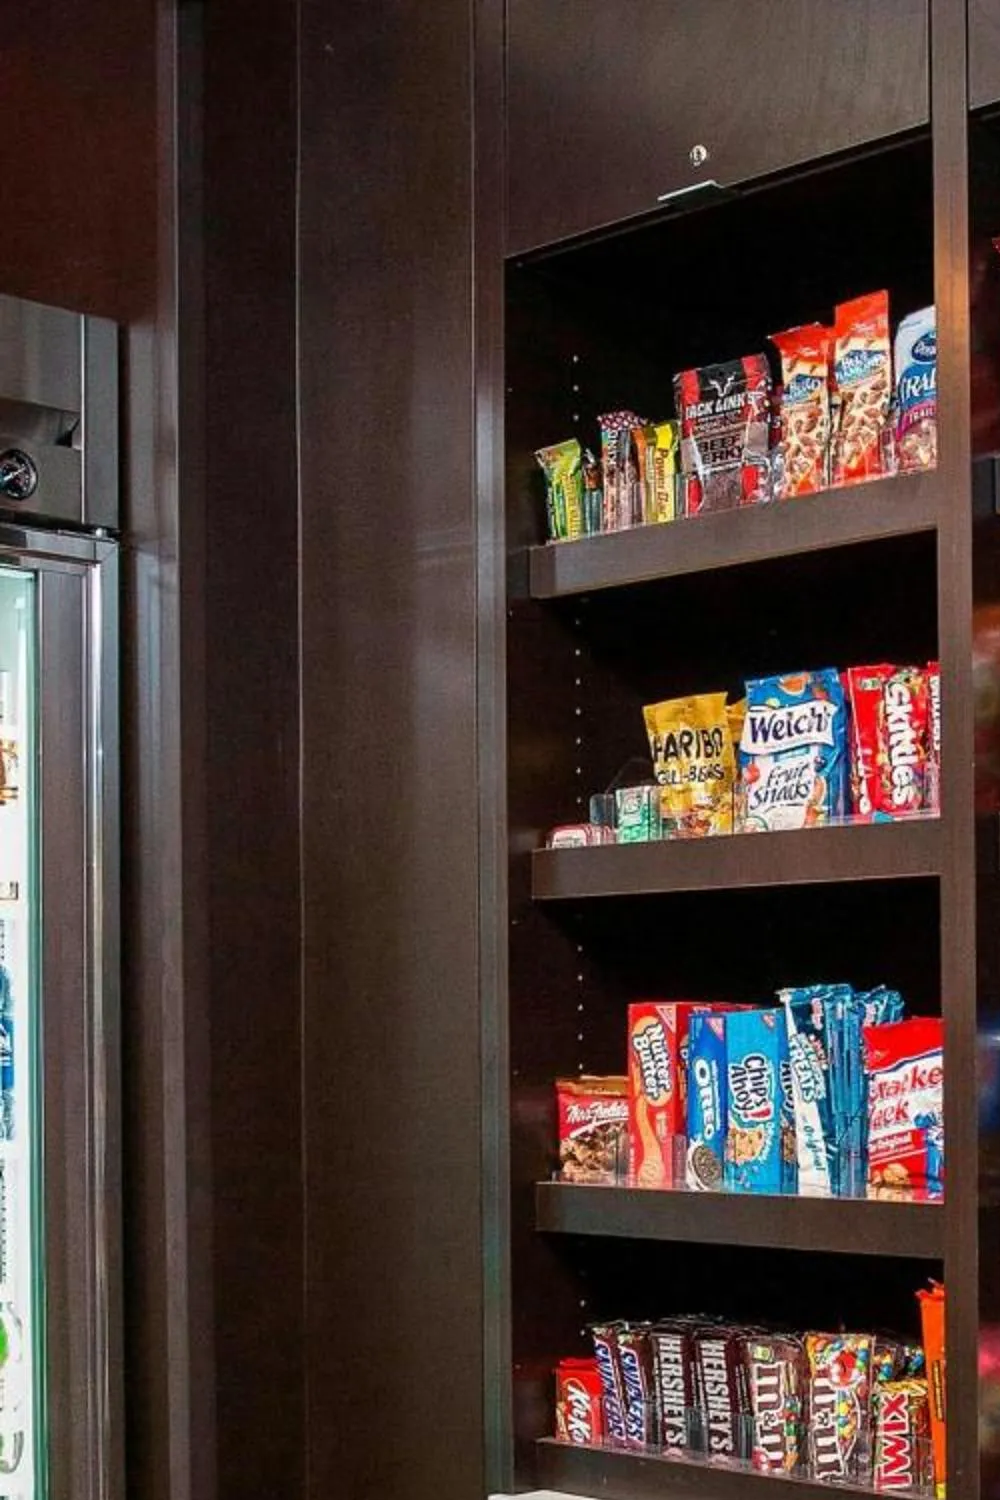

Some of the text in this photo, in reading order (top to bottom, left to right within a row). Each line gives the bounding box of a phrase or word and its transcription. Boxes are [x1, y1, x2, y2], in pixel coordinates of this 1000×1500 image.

[699, 445, 745, 467] ERKY
[632, 1034, 661, 1101] Butter
[645, 1020, 672, 1093] Nutter
[743, 1055, 768, 1107] Chips
[694, 1057, 718, 1142] OREO
[658, 1335, 687, 1446] HERSHEY'S
[701, 1341, 734, 1452] HERSHEY'S
[874, 1390, 913, 1492] TWIX
